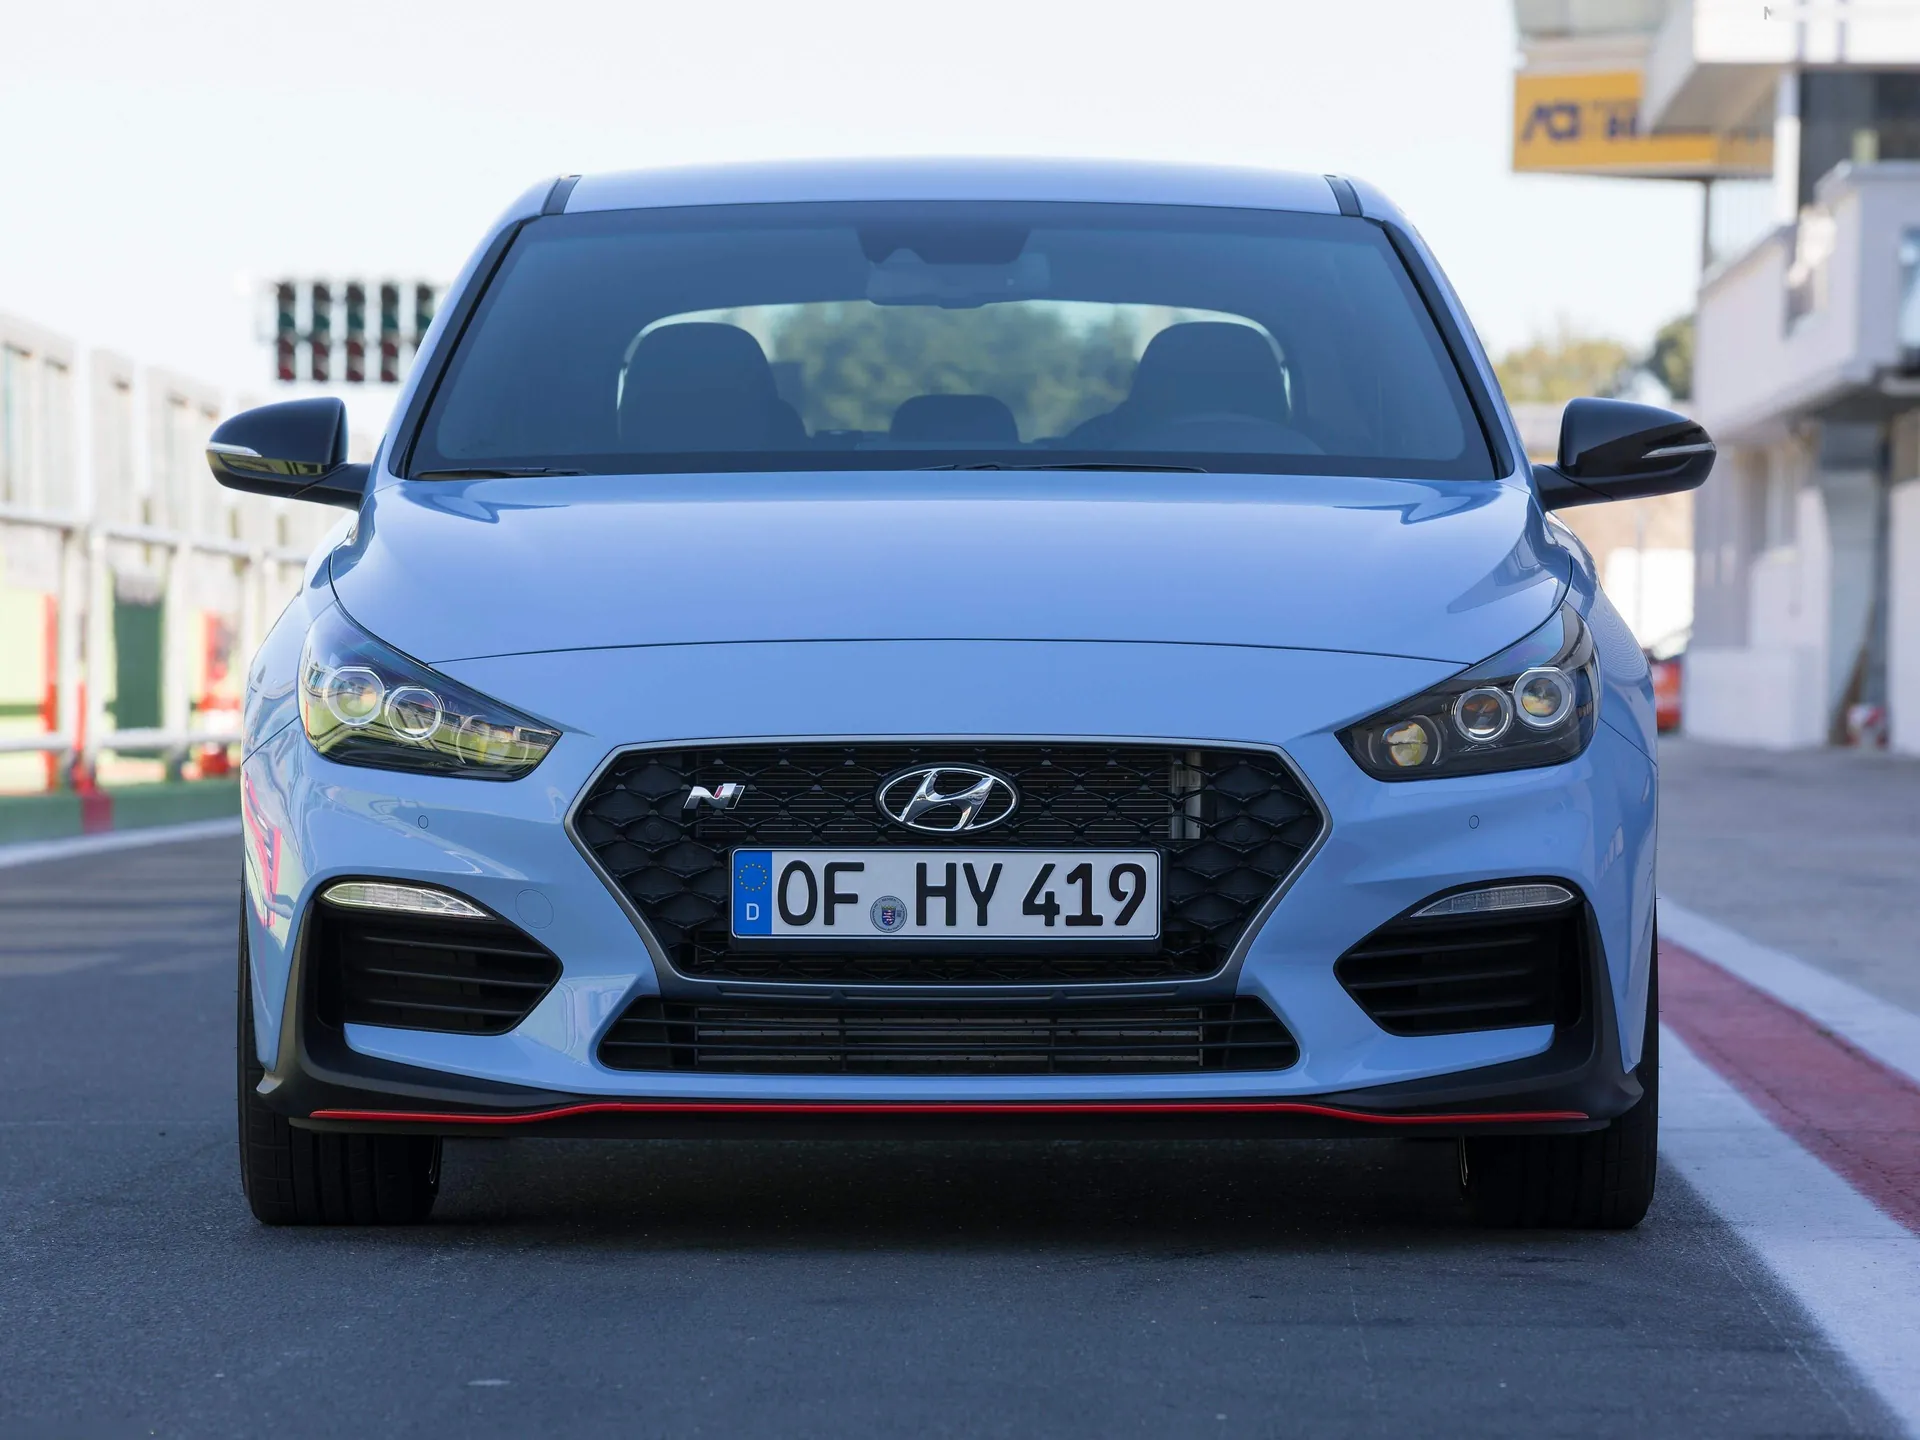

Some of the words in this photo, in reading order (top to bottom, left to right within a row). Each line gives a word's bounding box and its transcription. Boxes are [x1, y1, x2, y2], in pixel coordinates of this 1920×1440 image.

[745, 902, 760, 921] D
[777, 860, 865, 926] OF
[916, 862, 1003, 927] HY
[1022, 862, 1147, 927] 419
